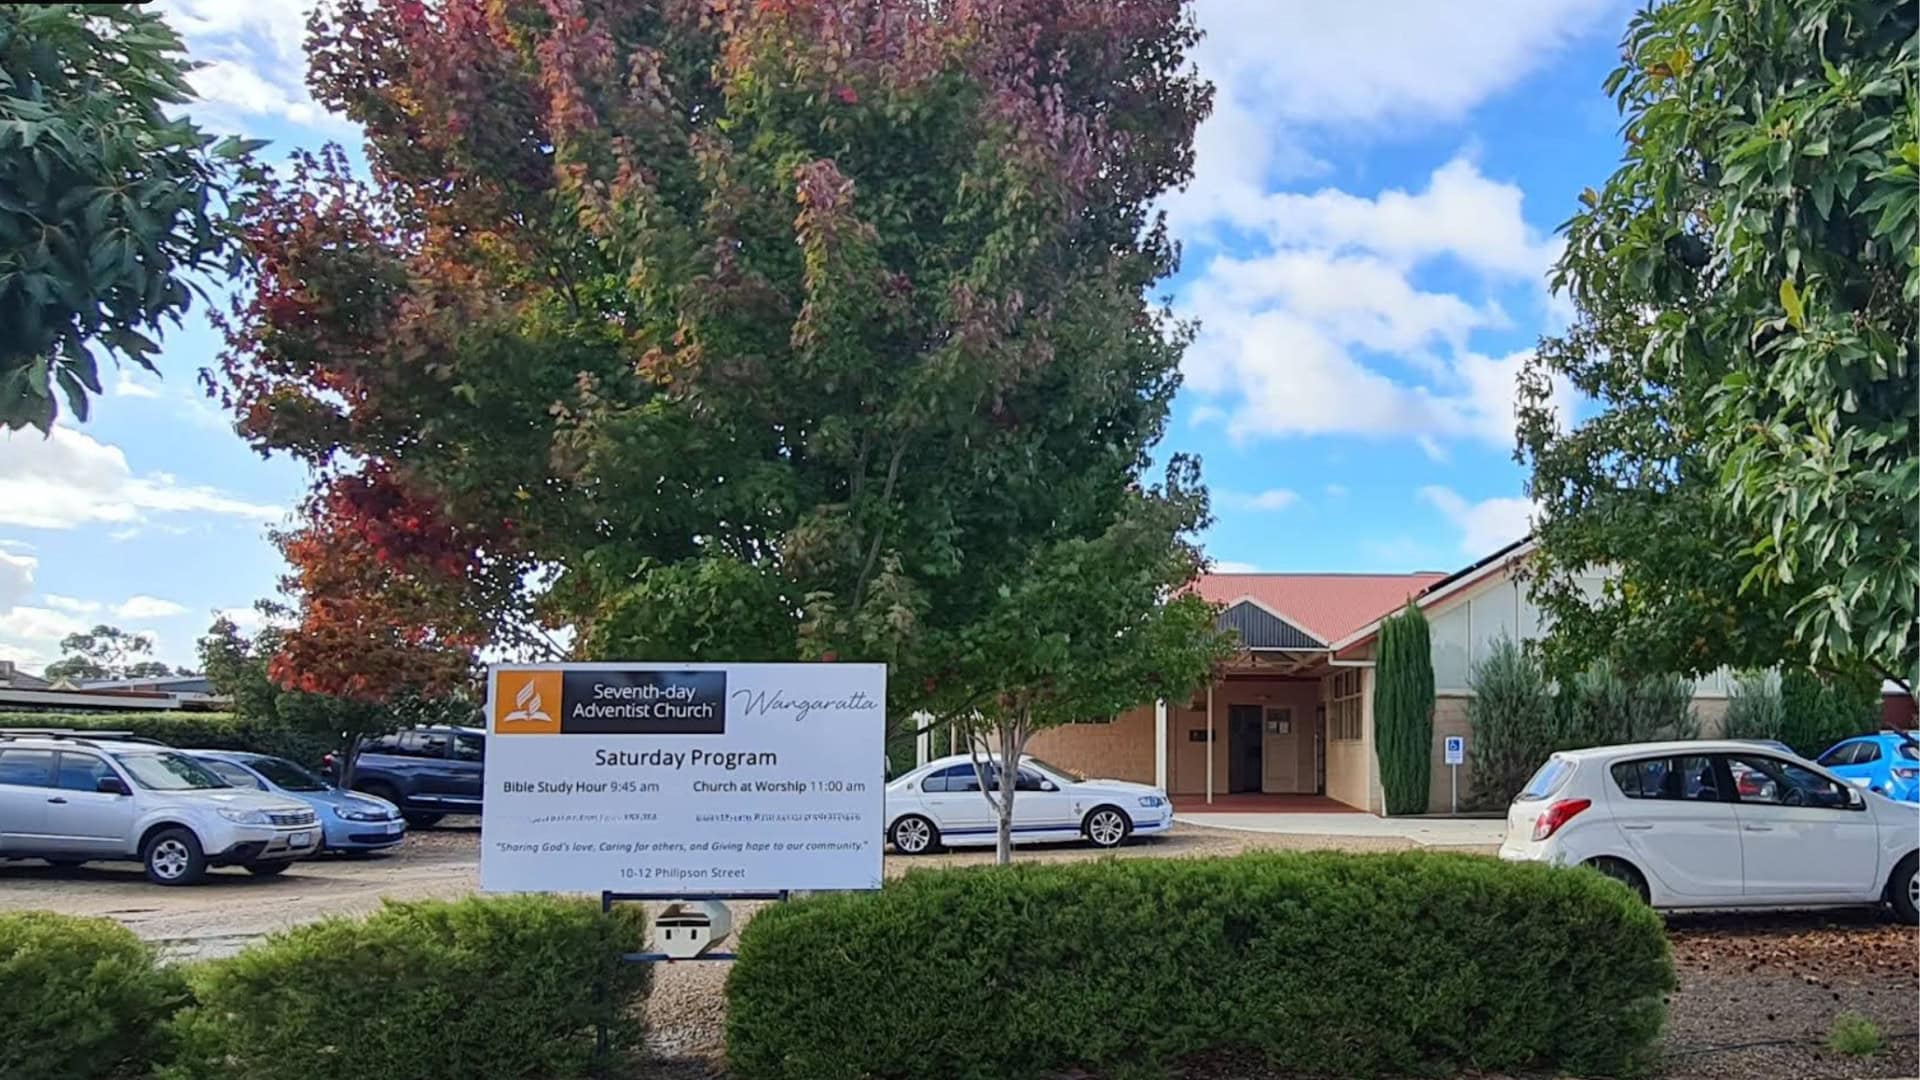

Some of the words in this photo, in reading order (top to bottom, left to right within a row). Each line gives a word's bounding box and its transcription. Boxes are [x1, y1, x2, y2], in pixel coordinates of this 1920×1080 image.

[593, 683, 696, 703] Seventh-day
[572, 703, 650, 718] Adventist
[732, 689, 878, 721] Wangaratta
[595, 749, 686, 770] Saturday
[691, 749, 777, 770] Program
[503, 781, 535, 793] Bible
[537, 781, 573, 795] Study
[576, 781, 608, 793] Hour
[610, 781, 637, 793] 9:45
[639, 783, 660, 793] am
[693, 780, 738, 792] Church
[740, 782, 752, 792] at
[755, 780, 807, 795] Worship
[810, 781, 843, 792] 11:00
[846, 782, 866, 792] am
[599, 841, 630, 853] Caring
[689, 842, 709, 851] and
[711, 842, 743, 852] Giving
[745, 842, 771, 852] hope
[773, 842, 784, 851] to
[786, 842, 804, 851] our
[620, 868, 652, 879] 10-12
[655, 867, 708, 880] Philipson
[711, 867, 745, 878] Street
